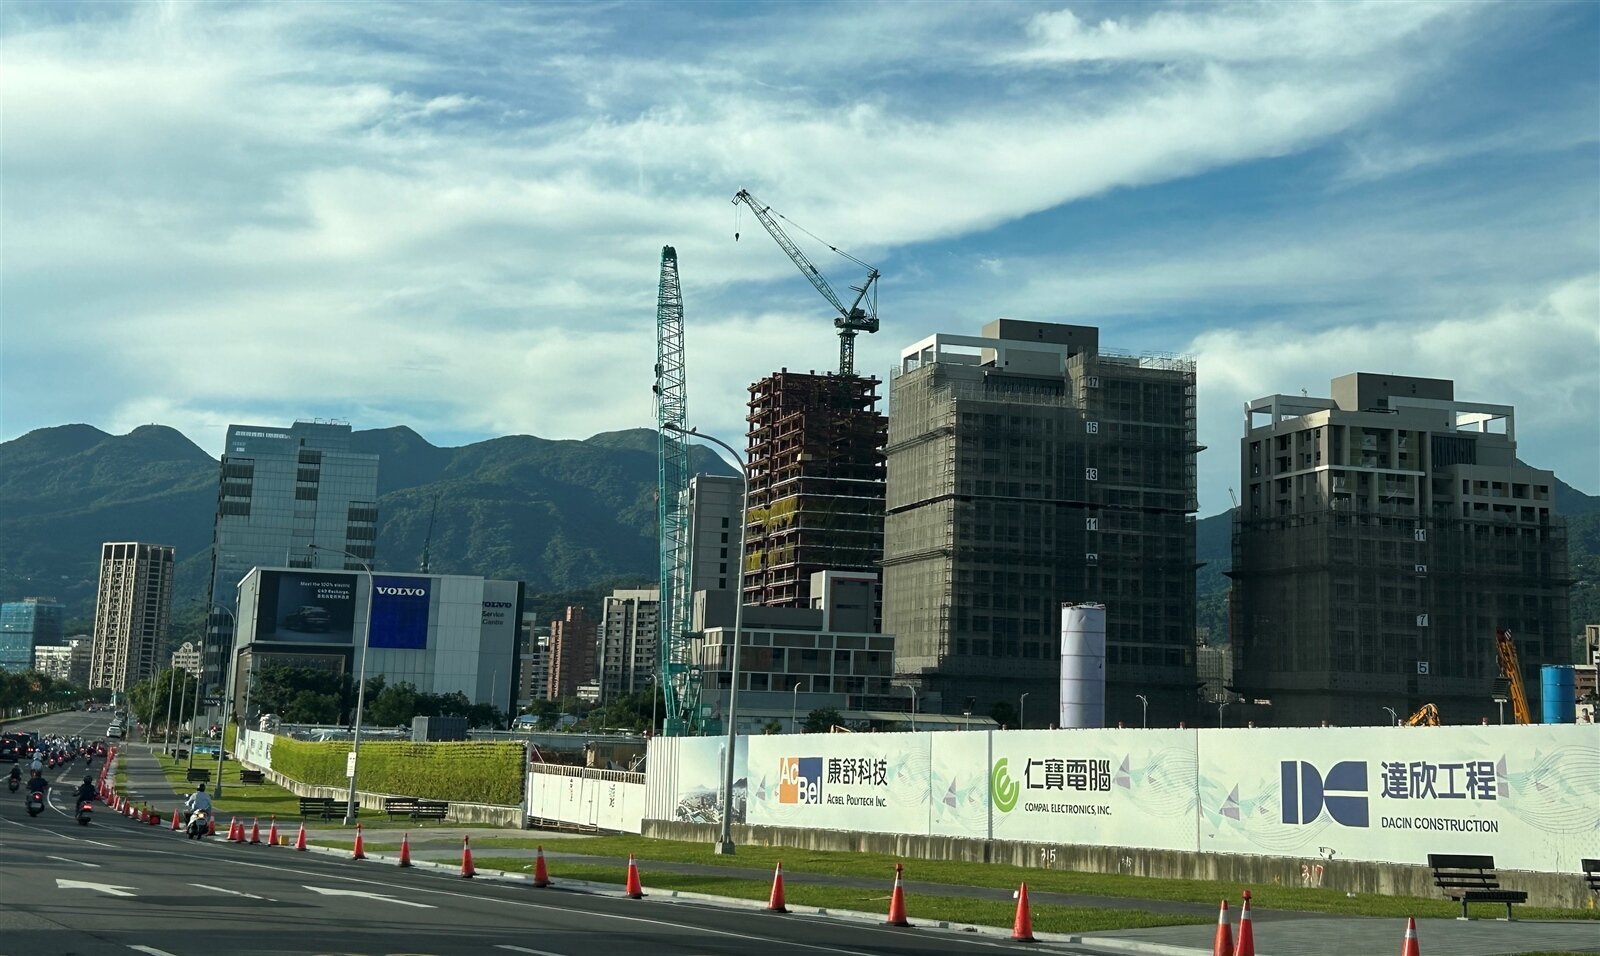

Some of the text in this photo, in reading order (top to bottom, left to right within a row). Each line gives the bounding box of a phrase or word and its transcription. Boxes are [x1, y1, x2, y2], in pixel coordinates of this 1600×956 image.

[1088, 377, 1097, 386] 17
[1087, 469, 1097, 479] 13
[1087, 519, 1097, 530] 11
[1416, 530, 1425, 540] 11
[376, 586, 425, 596] VOLVO
[1419, 663, 1427, 673] 5
[827, 757, 888, 786] 康舒科技
[1024, 758, 1111, 791] 仁寶電腦
[1381, 761, 1496, 800] 達欣工程
[1025, 803, 1112, 815] COMPAL ELECTRONICS, INC.
[1381, 817, 1498, 832] DACIN CONSTRUCTION
